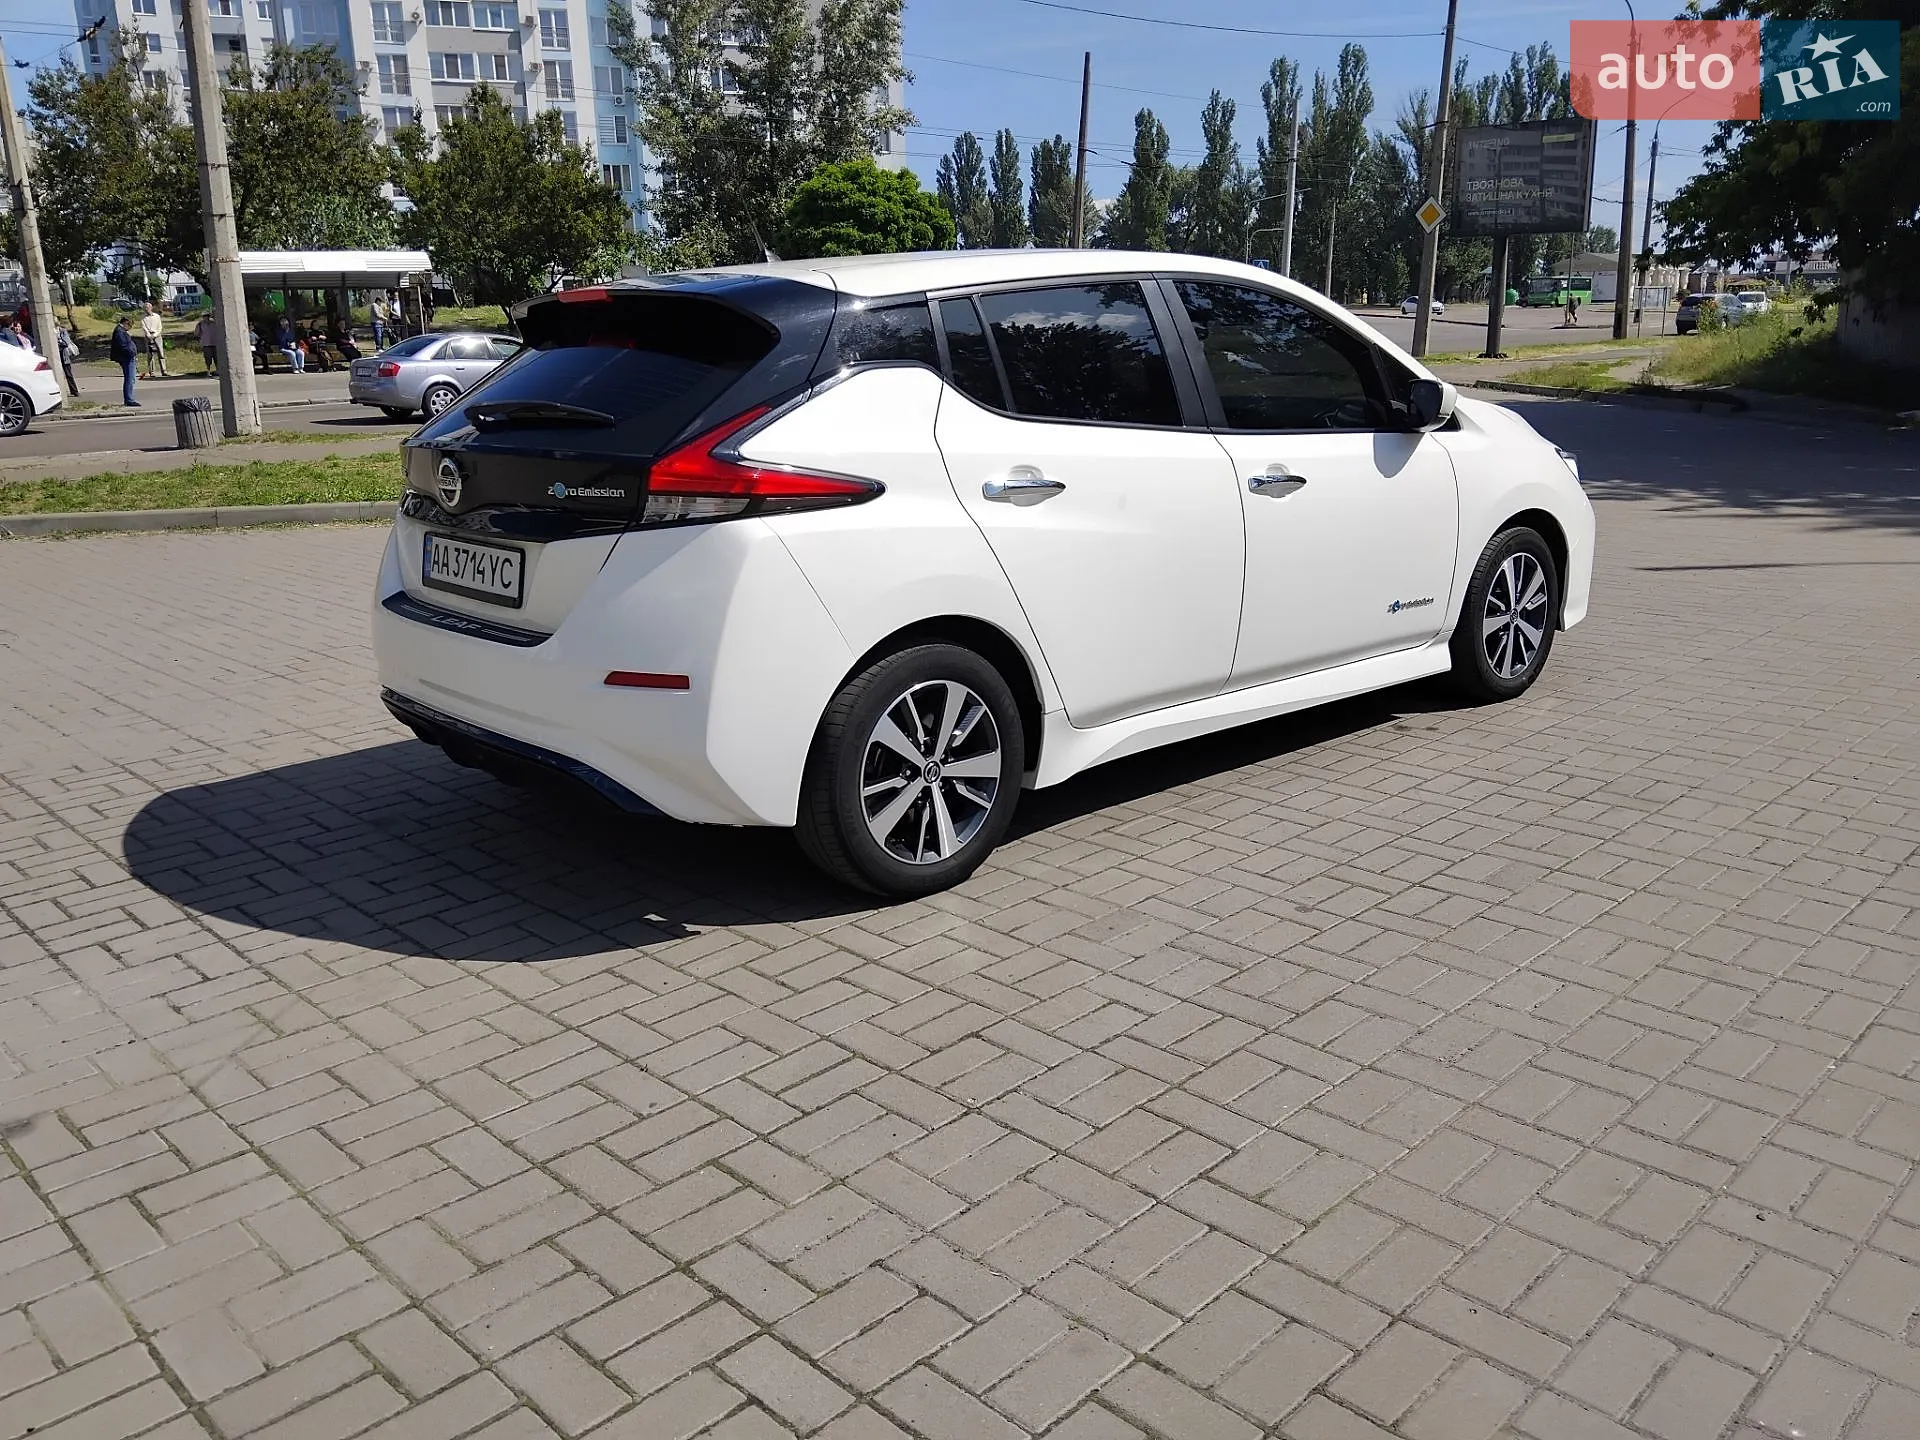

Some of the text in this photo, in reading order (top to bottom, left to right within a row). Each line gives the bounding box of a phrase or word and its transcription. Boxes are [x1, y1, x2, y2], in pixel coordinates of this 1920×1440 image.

[1466, 180, 1495, 191] ТВОЯ
[577, 487, 625, 497] Emission
[432, 543, 514, 589] AA 3714 YC
[431, 615, 482, 629] LEAF
